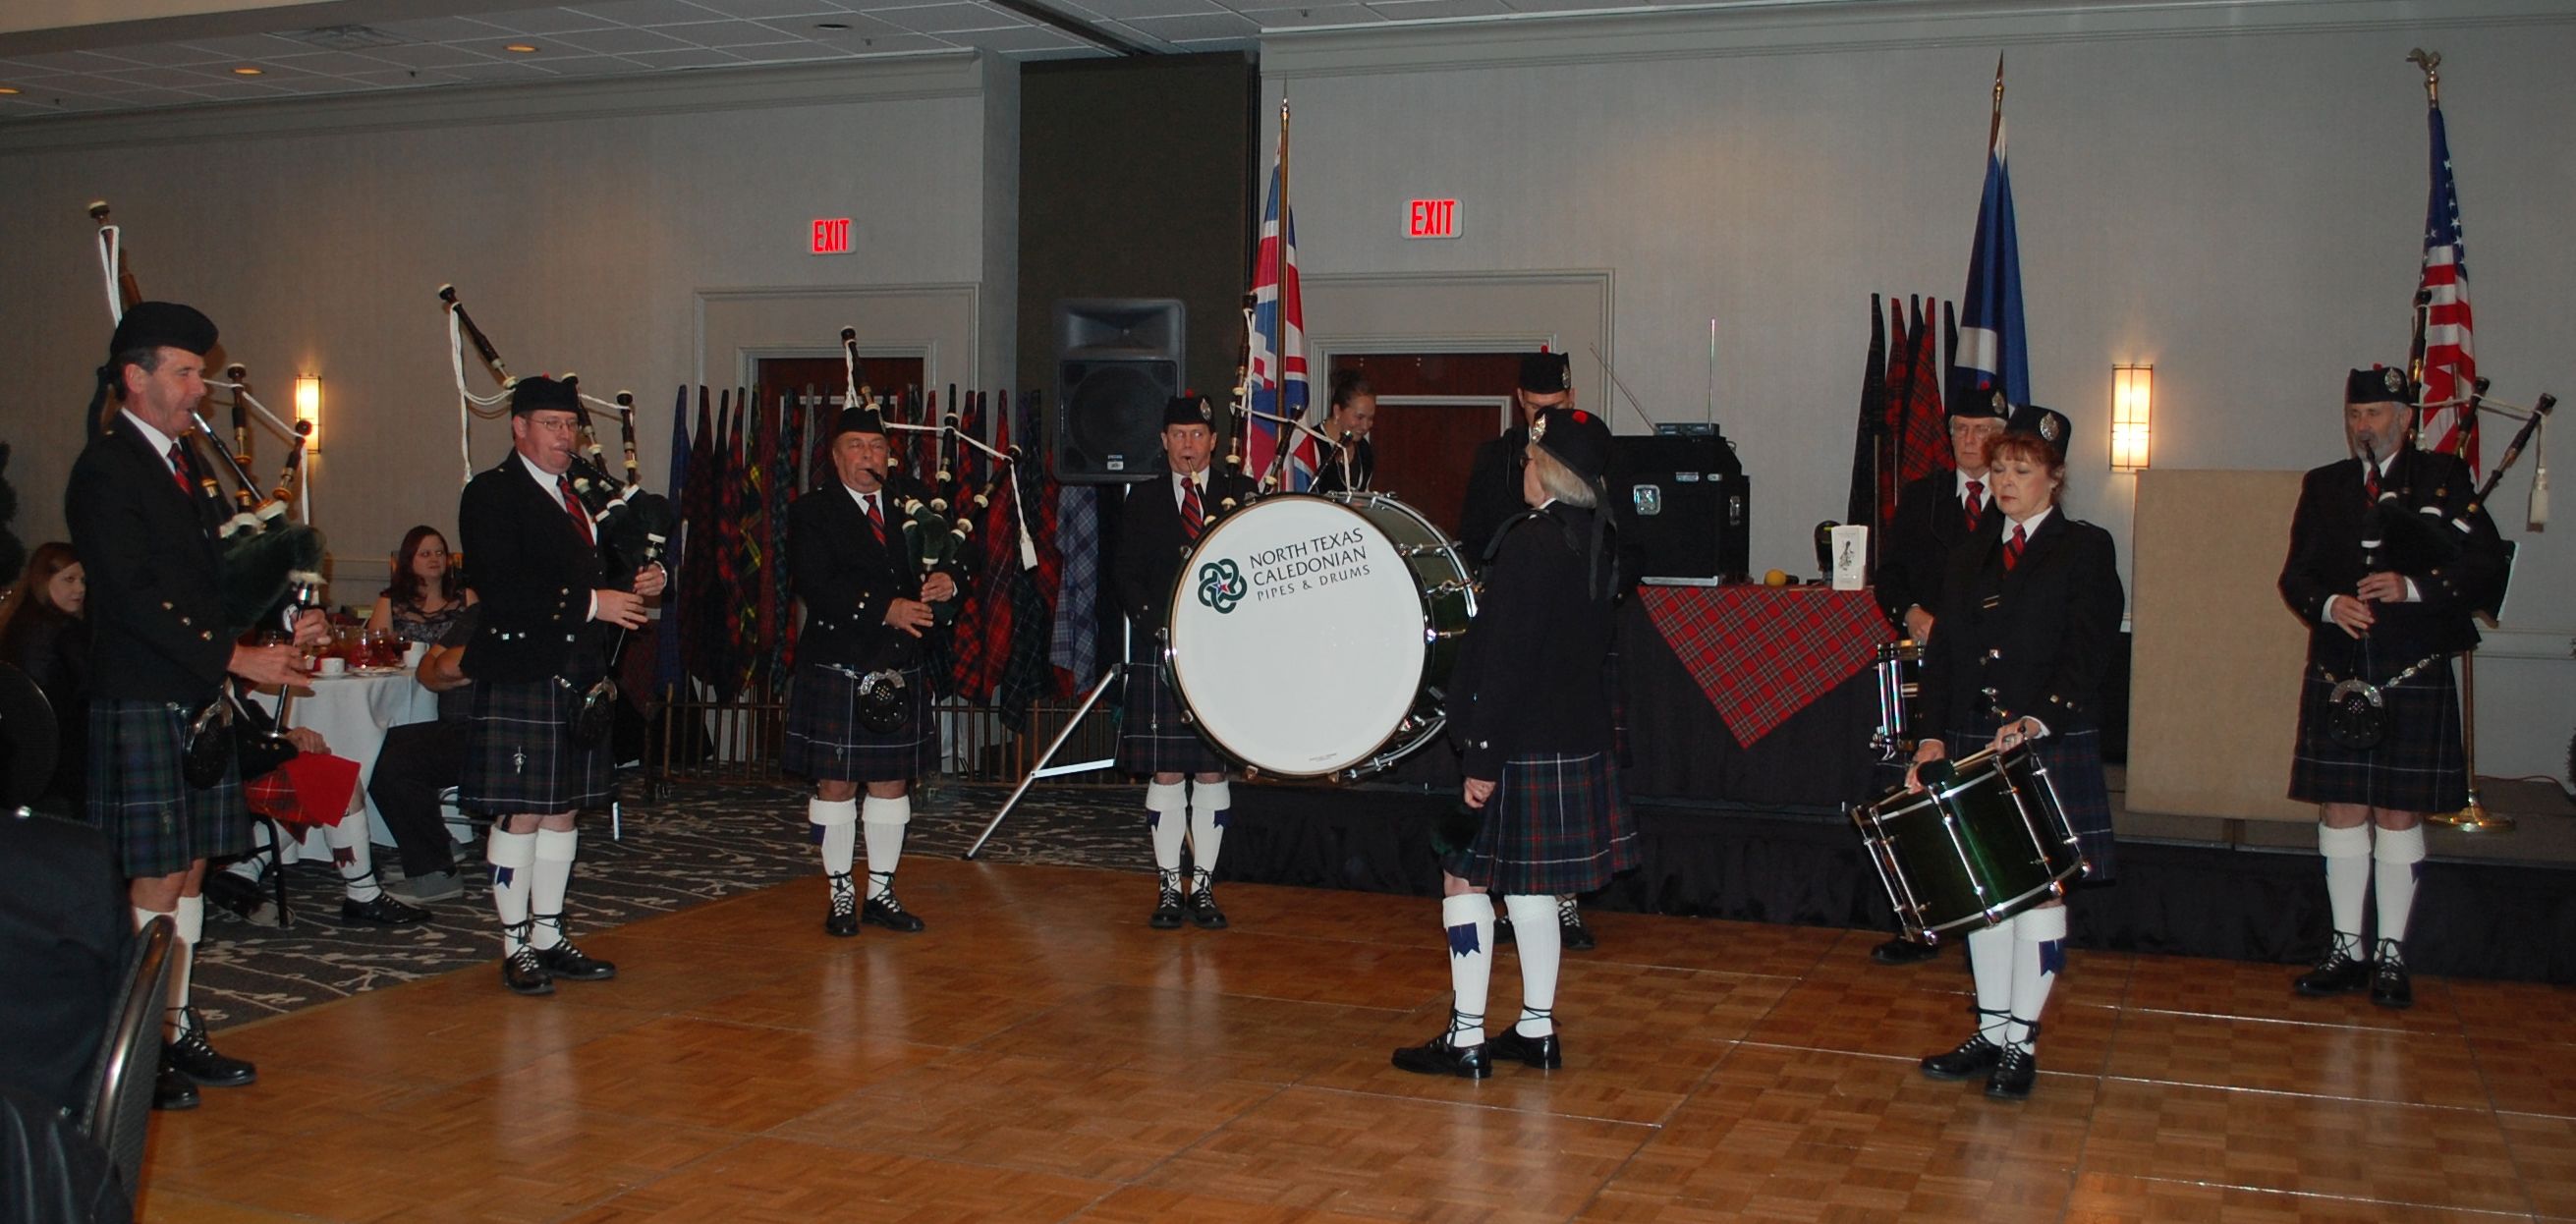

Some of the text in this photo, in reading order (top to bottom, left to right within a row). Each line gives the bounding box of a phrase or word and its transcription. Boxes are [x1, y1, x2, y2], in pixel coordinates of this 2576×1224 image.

[812, 219, 850, 252] EXIT
[1410, 199, 1455, 236] EXIT
[1250, 528, 1364, 569] NORTH TEXAS
[1254, 545, 1367, 585] CALEDONIAN
[1258, 564, 1371, 601] PIPES & DRUMS
